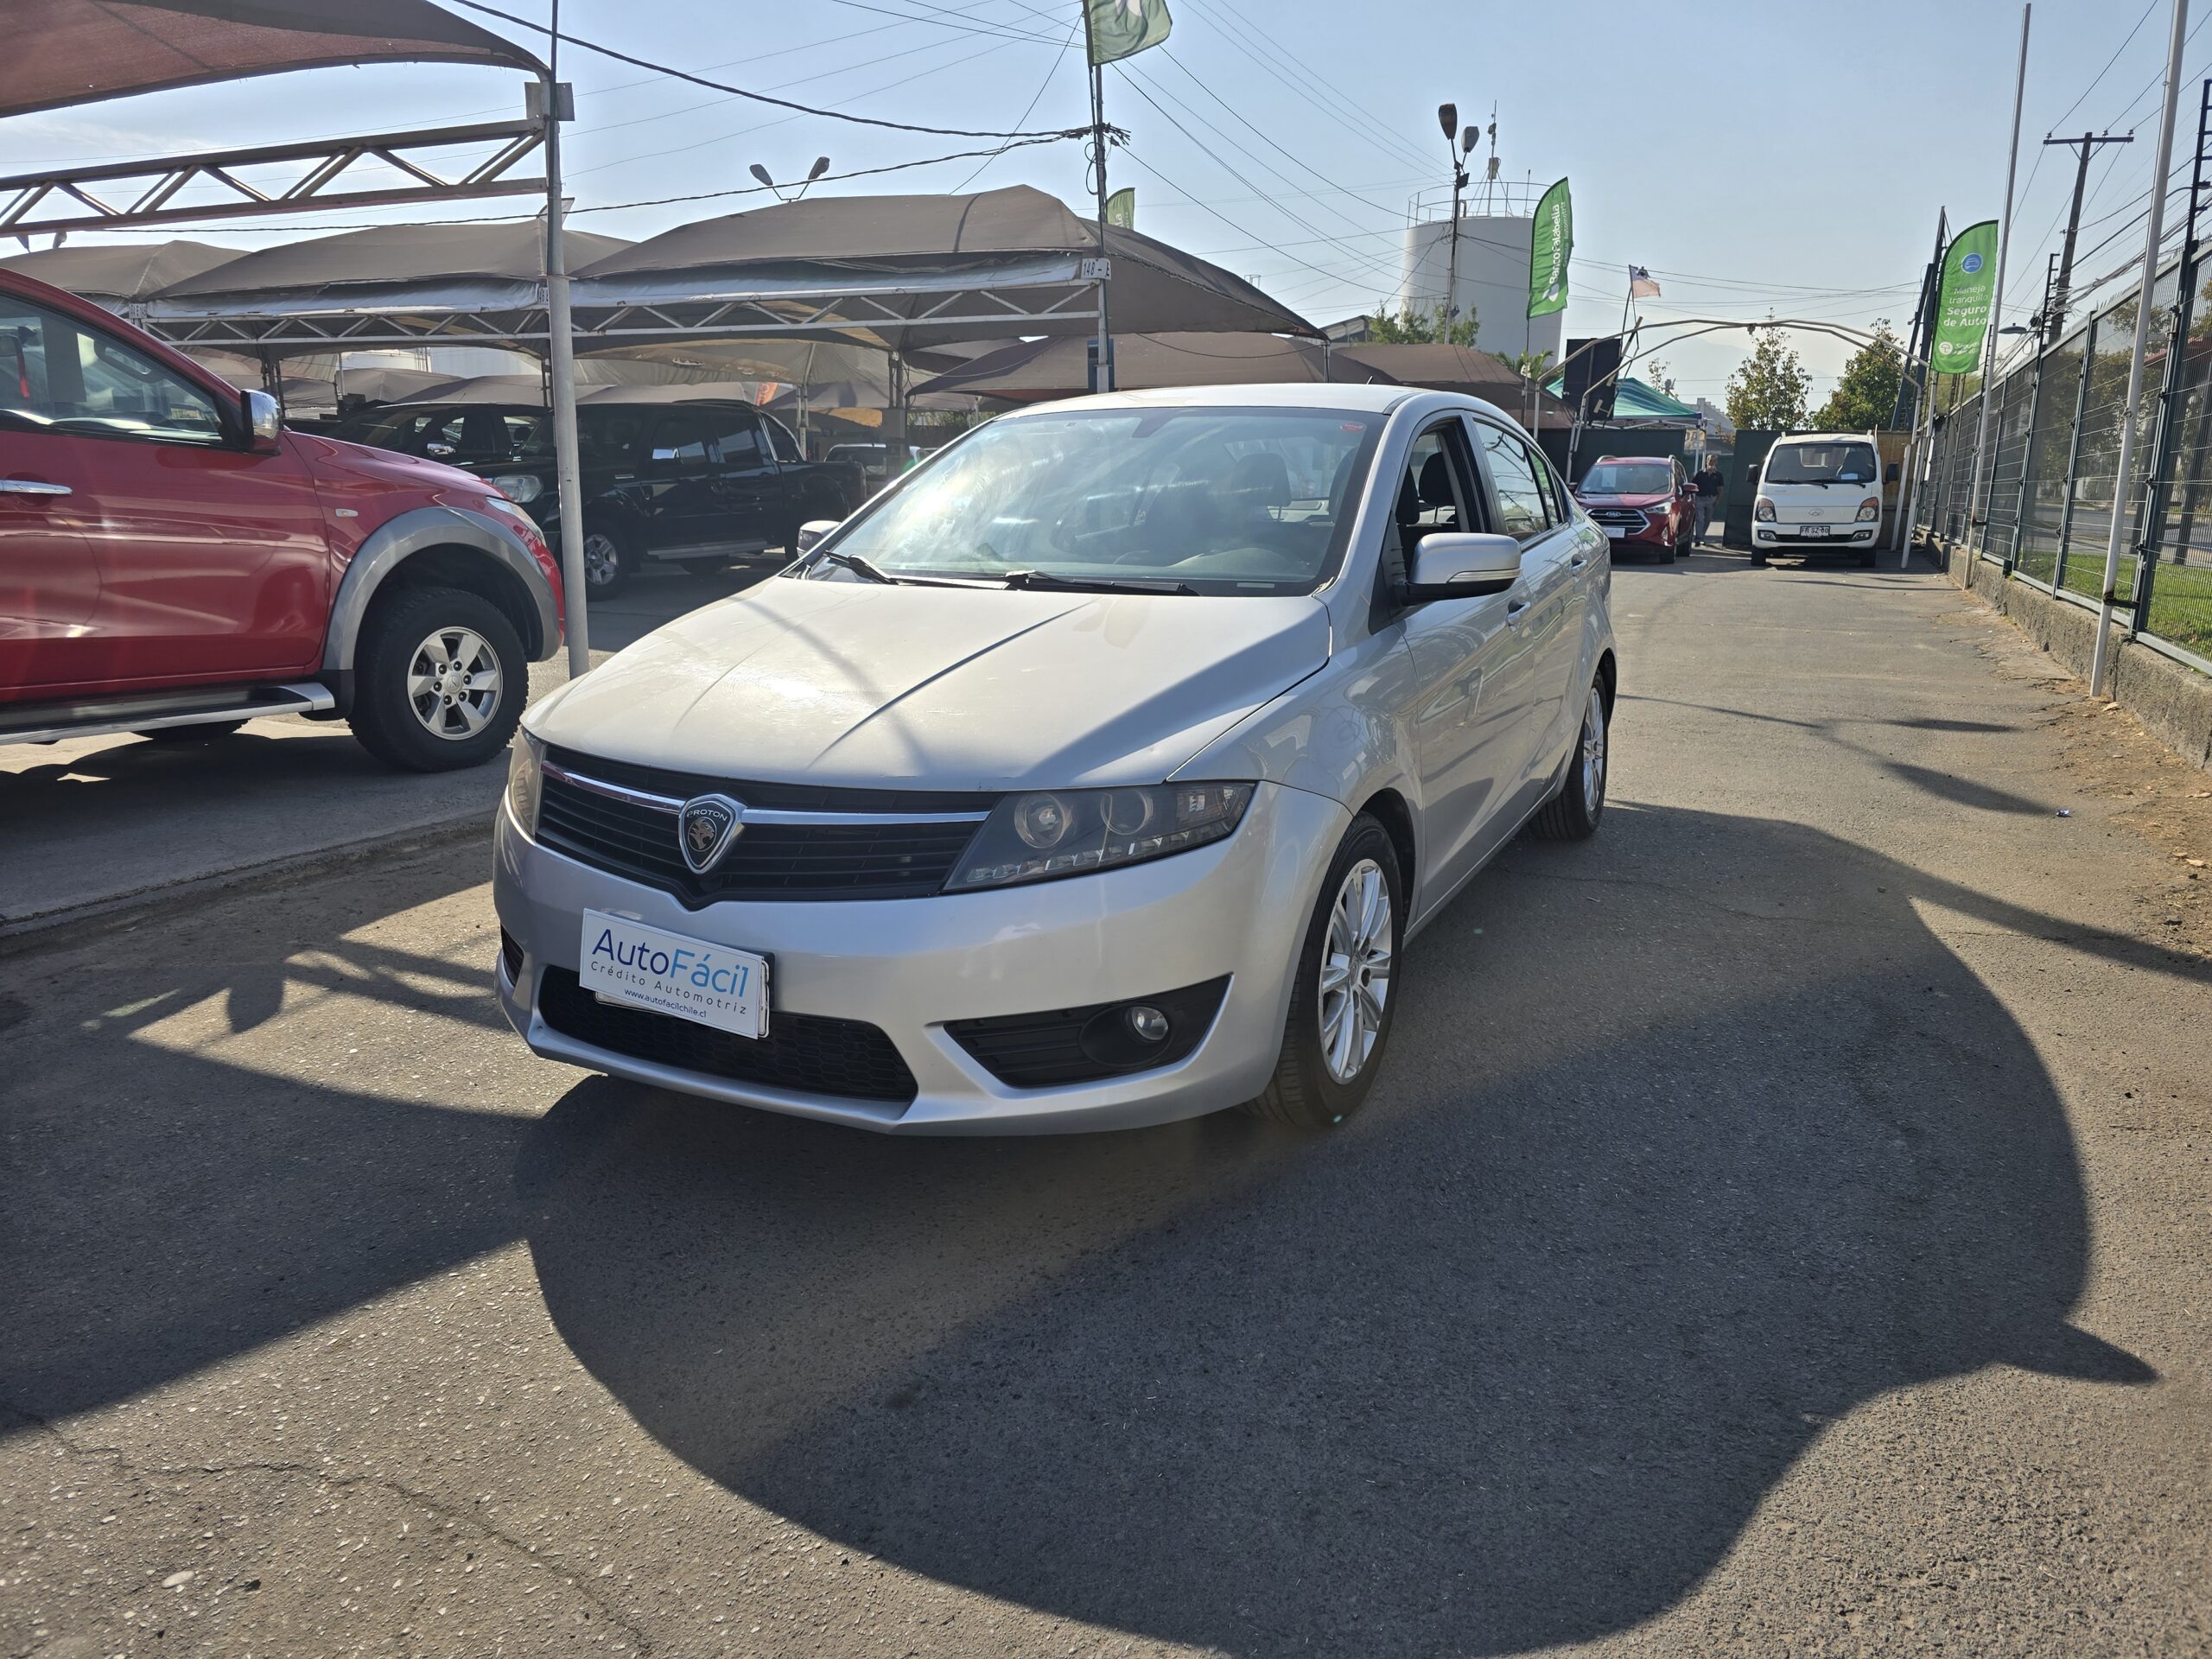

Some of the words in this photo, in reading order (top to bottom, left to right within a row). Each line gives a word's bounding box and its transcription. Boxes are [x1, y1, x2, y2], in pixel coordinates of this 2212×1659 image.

[1549, 204, 1560, 284] BancoFalabella
[1084, 262, 1095, 276] 148
[1949, 294, 1988, 304] tranquilo
[1947, 306, 1986, 317] Seguro
[1943, 317, 1957, 327] de
[1959, 316, 1987, 327] Auto
[686, 809, 728, 822] PROTON
[592, 928, 748, 997] AutoFácil
[590, 960, 645, 986] Crédito
[654, 981, 747, 1014] Automotriz
[624, 988, 707, 1019] www.autofacilchile.cl
